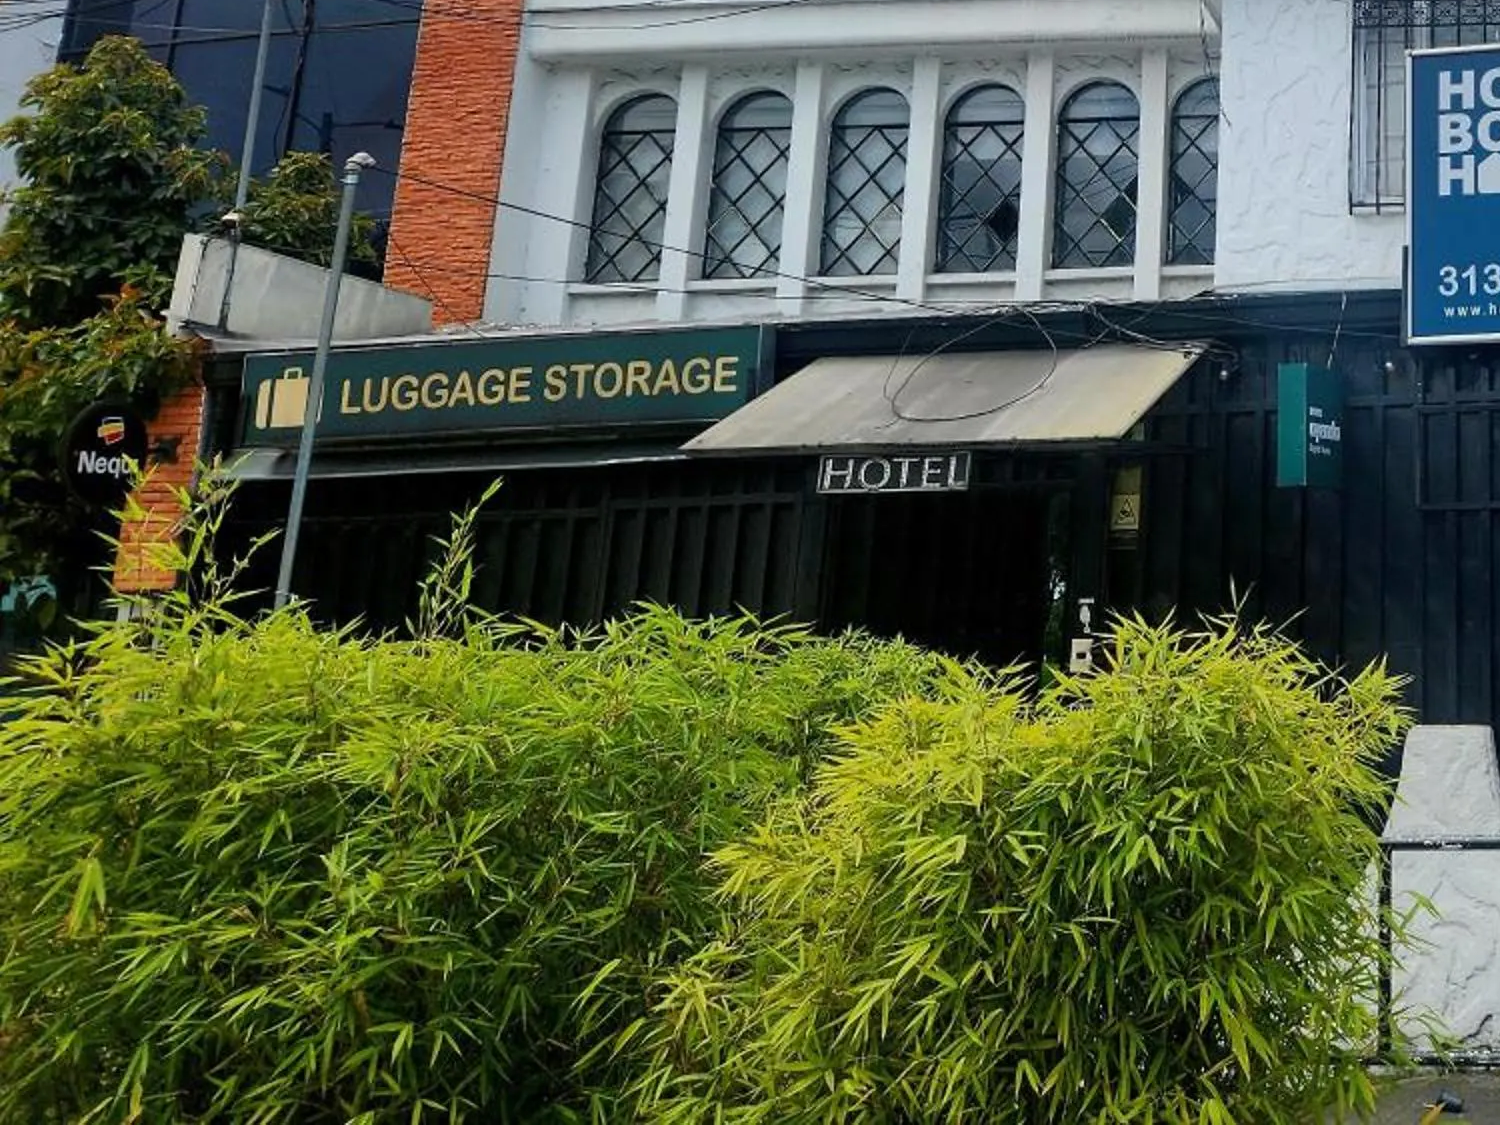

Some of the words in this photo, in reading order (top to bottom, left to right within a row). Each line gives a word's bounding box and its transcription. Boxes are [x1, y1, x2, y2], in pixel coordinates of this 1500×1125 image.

[340, 366, 532, 415] LUGGAGE
[543, 355, 740, 403] STORAGE
[77, 450, 139, 479] Nequ
[822, 455, 968, 490] HOTEL
